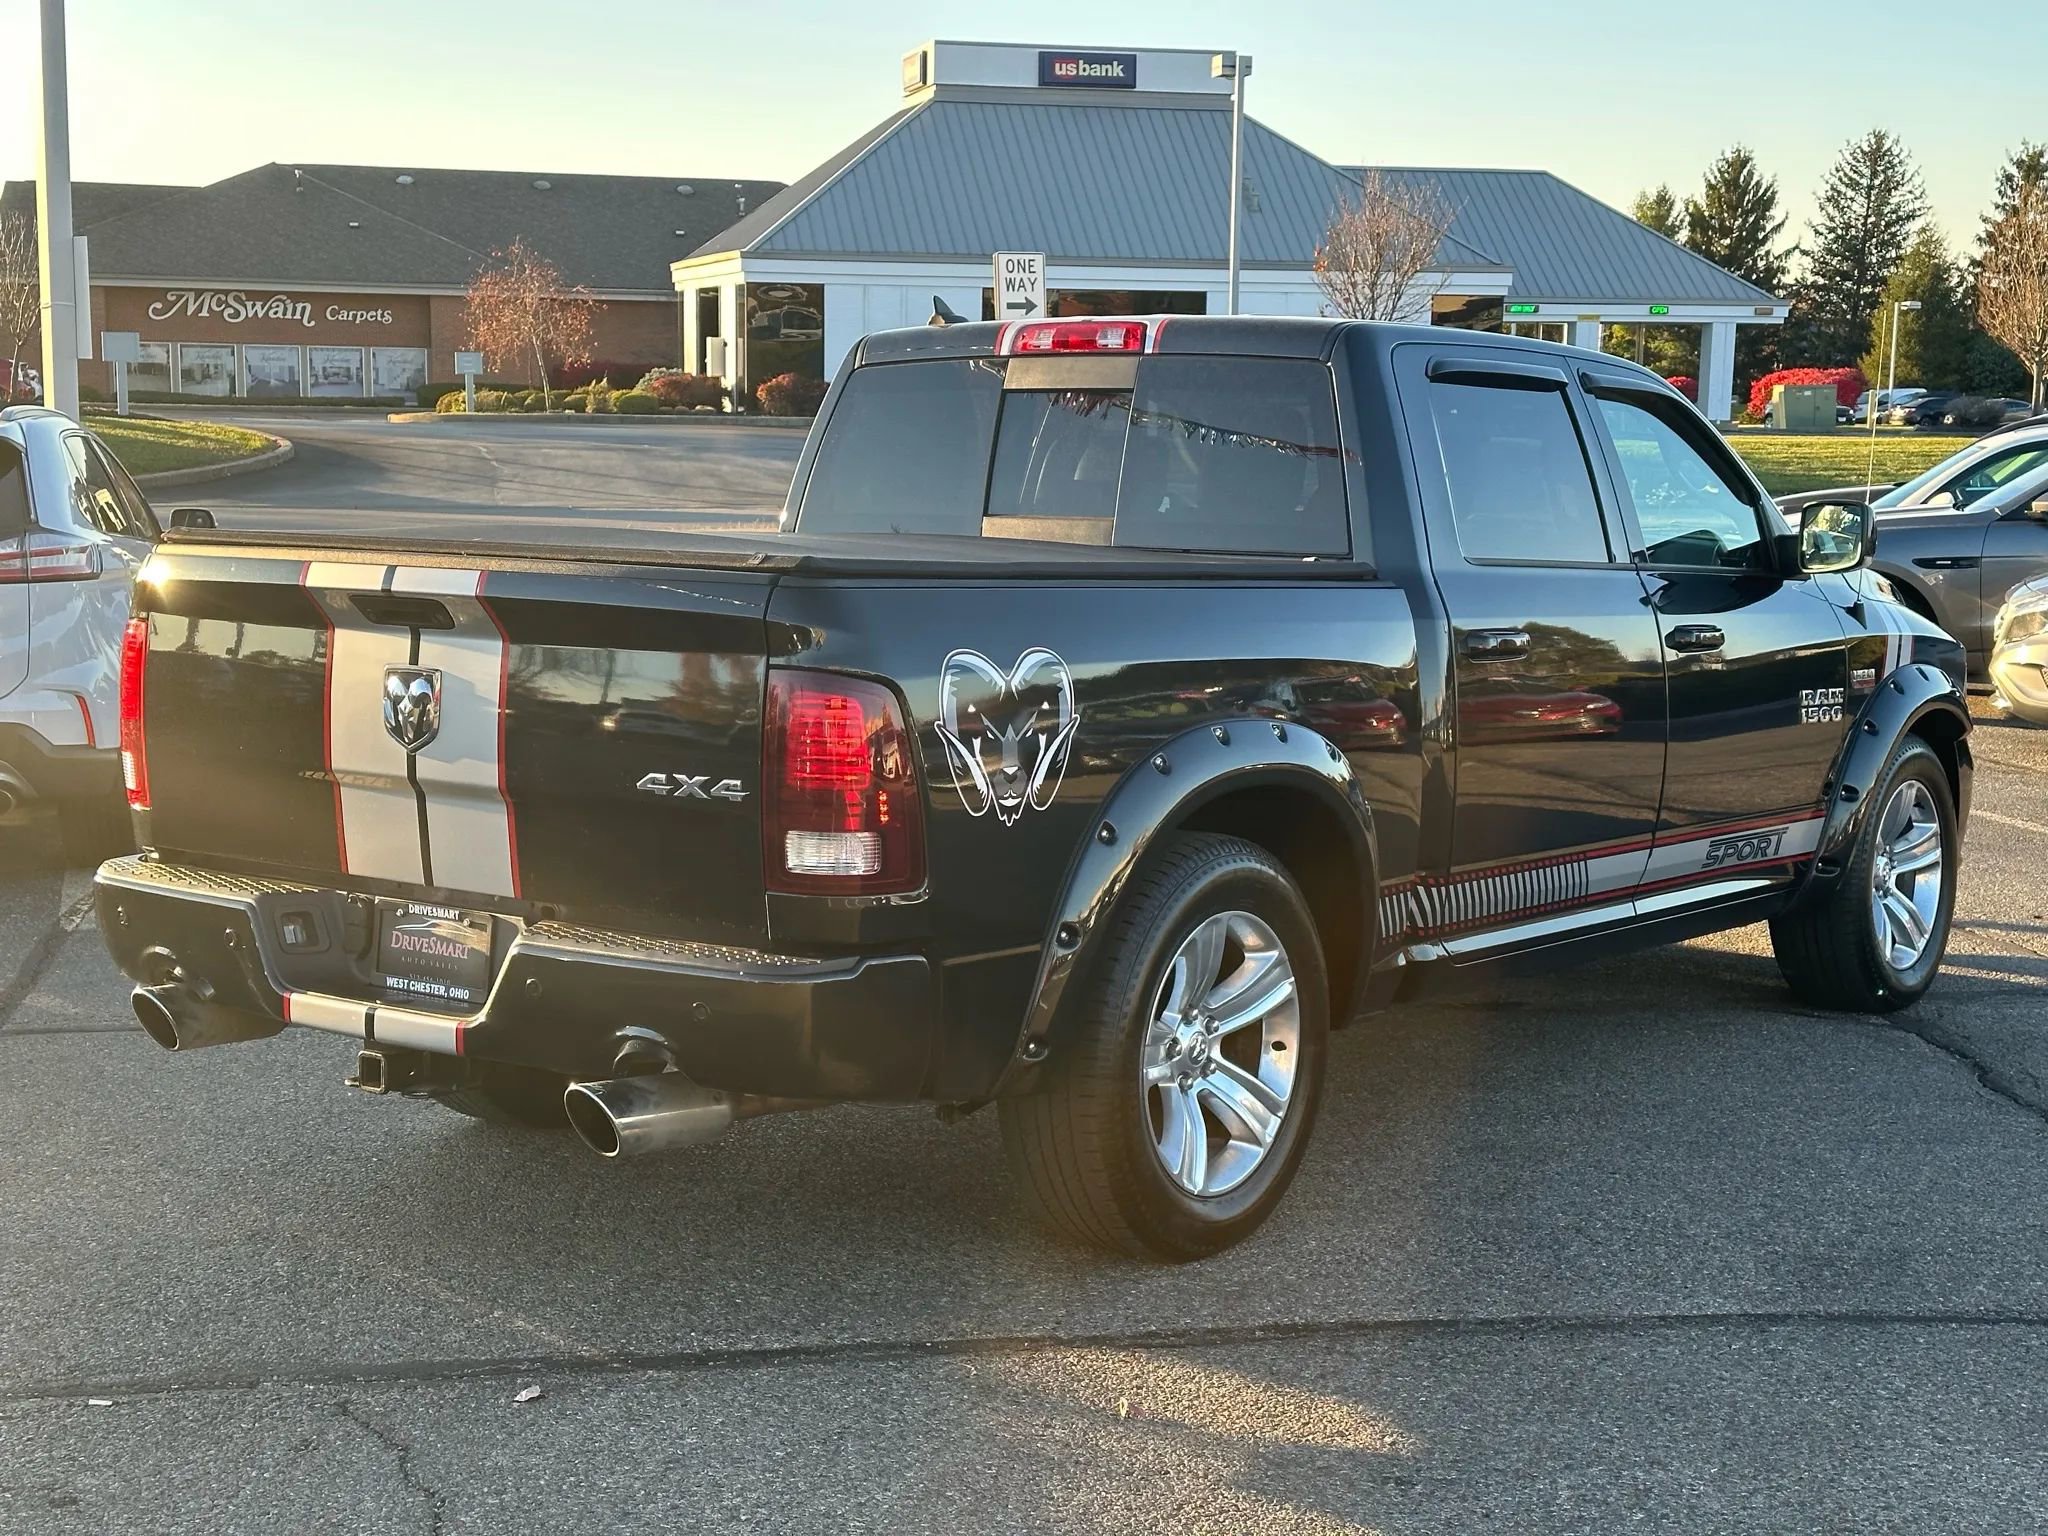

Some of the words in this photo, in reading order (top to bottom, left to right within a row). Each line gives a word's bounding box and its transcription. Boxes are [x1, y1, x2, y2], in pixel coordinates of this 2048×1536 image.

[1005, 258, 1037, 274] ONE
[1005, 276, 1038, 293] WAY
[148, 291, 316, 328] McSwain
[325, 305, 393, 325] Carpets
[1799, 687, 1845, 706] RAM
[1800, 705, 1843, 724] 1500
[635, 772, 751, 802] 4X4
[1700, 826, 1790, 870] SPORT
[408, 903, 460, 921] DRIVESMART
[386, 976, 409, 989] WEST
[409, 980, 448, 998] CHESTER,
[449, 986, 470, 1000] OHIO
